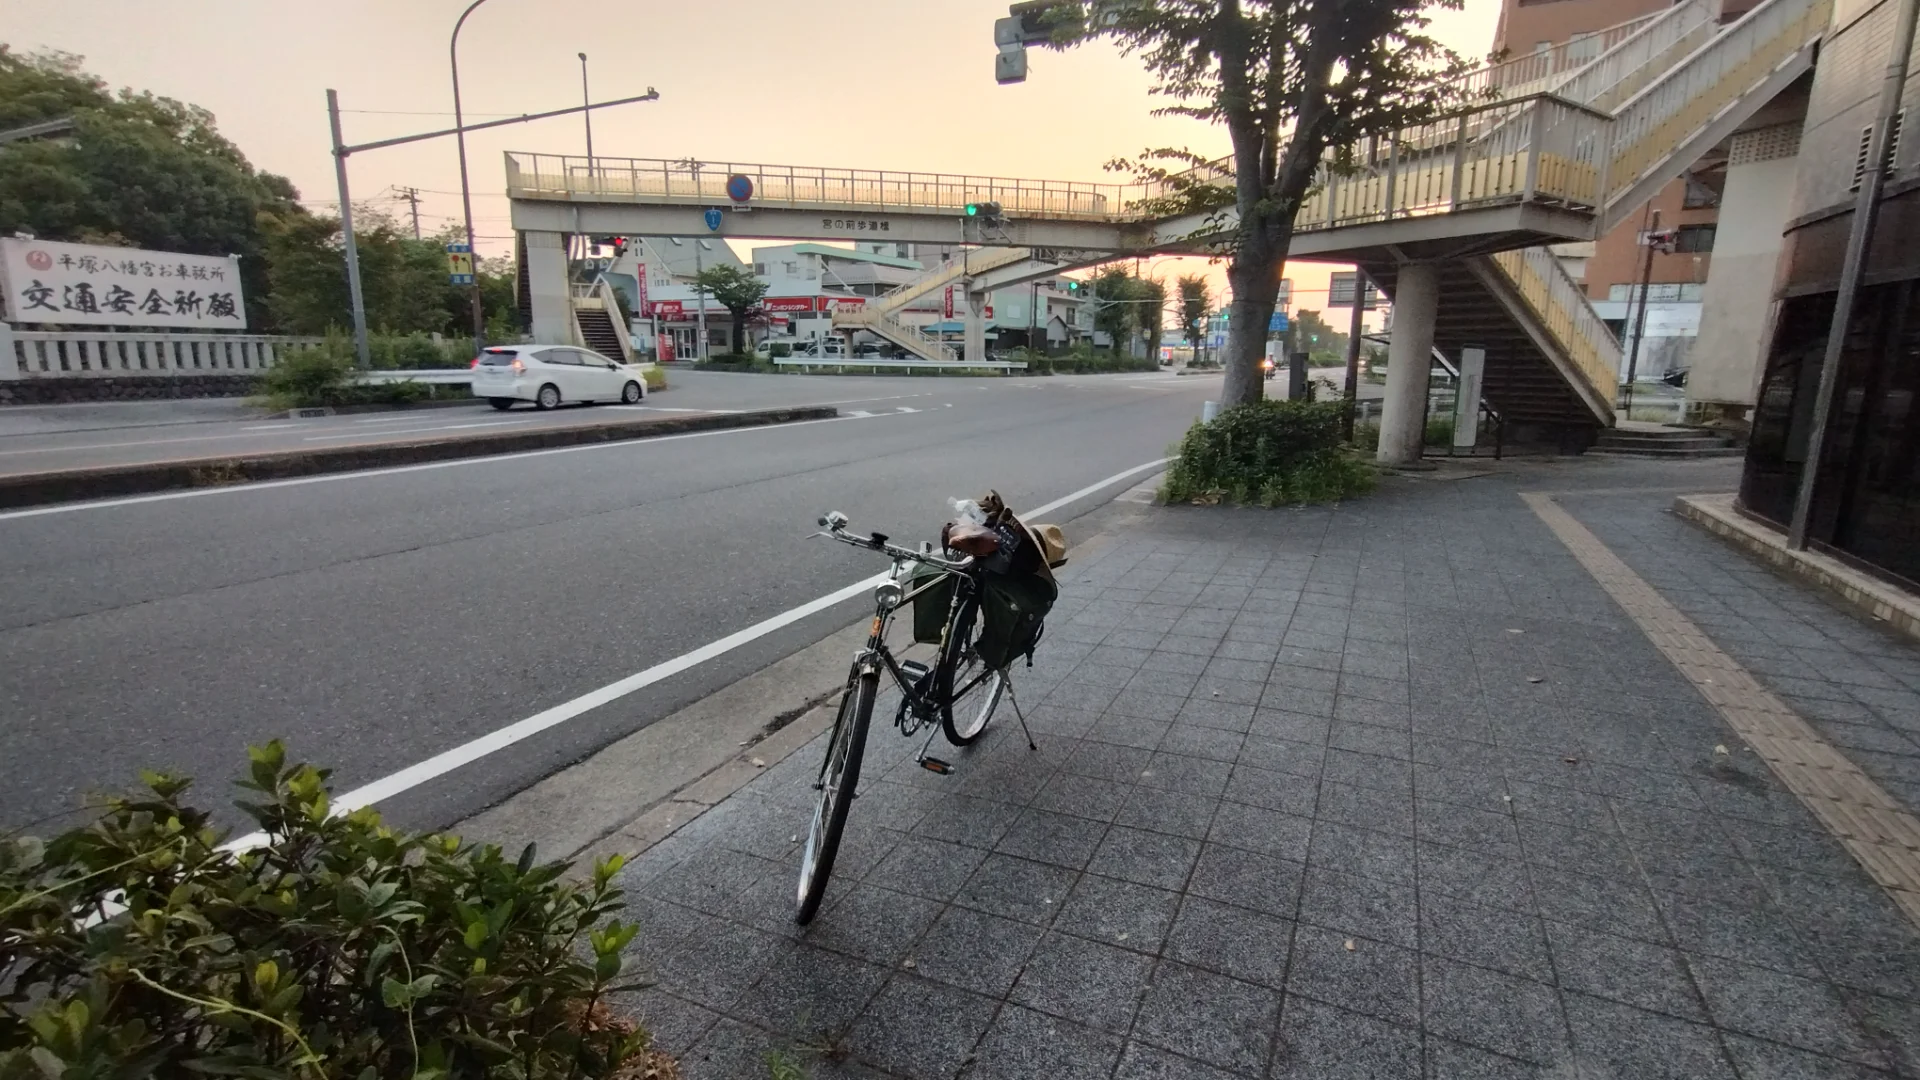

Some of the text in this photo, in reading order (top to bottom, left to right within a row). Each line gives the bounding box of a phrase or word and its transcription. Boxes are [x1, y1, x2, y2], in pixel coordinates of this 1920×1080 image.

[822, 219, 890, 231] 宮の前歩道橋
[57, 253, 226, 282] 平塚八幡宮お車祓所
[21, 279, 240, 321] 交通安全祈願
